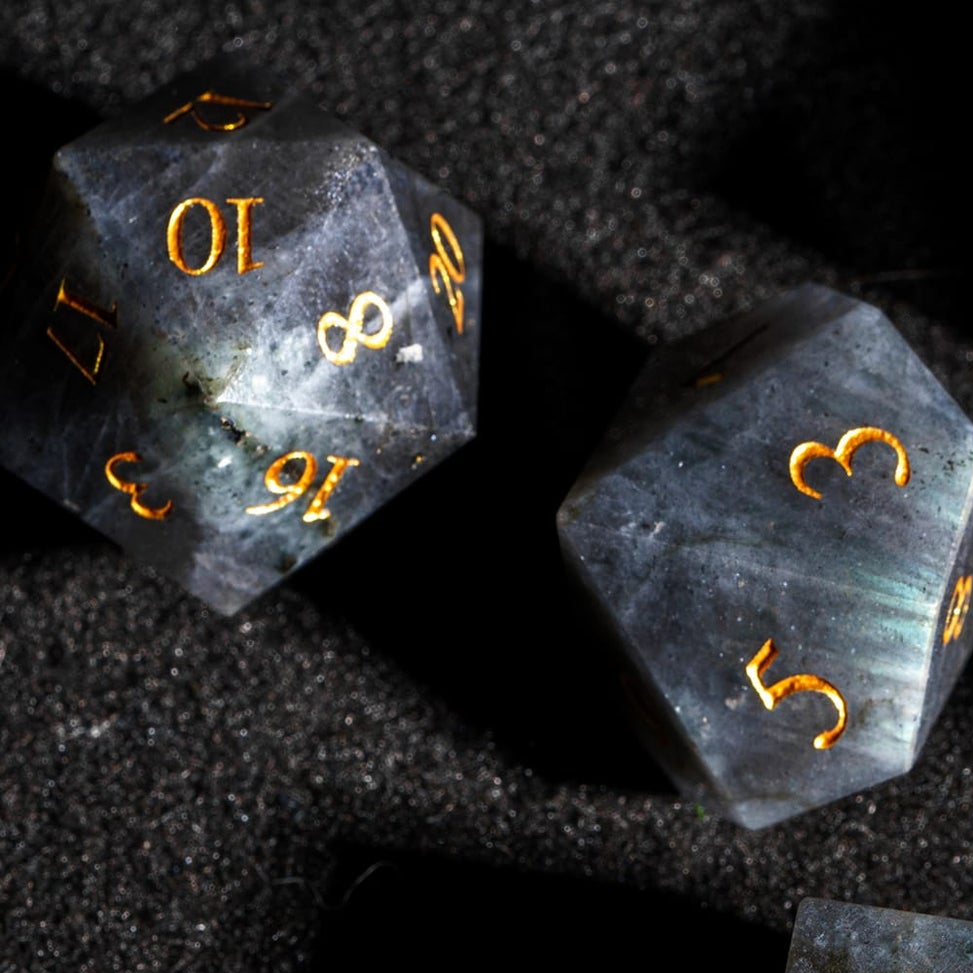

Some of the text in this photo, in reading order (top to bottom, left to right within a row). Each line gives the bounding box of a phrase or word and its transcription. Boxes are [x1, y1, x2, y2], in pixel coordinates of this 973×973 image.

[166, 197, 265, 276] 10
[428, 212, 465, 335] 20
[46, 276, 118, 387] 17
[318, 291, 394, 366] 8
[105, 452, 172, 520] 3
[789, 426, 910, 499] 3
[745, 638, 848, 750] 5
